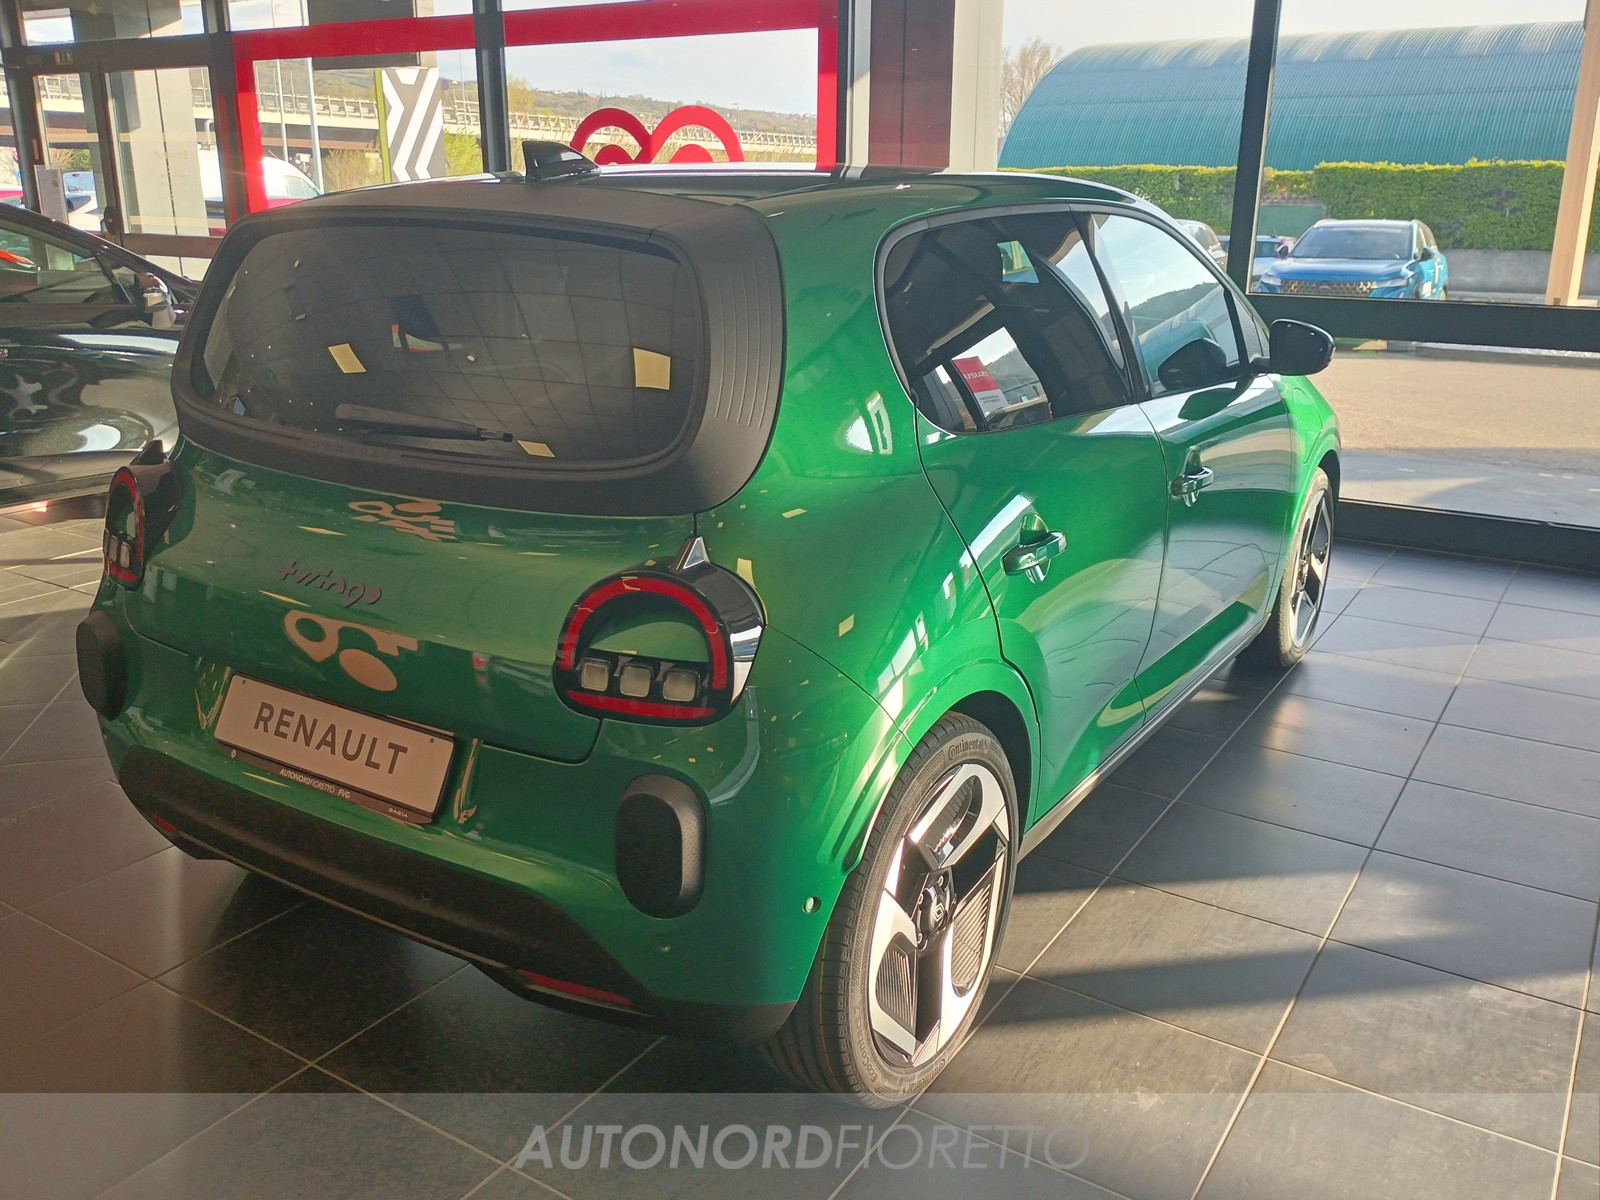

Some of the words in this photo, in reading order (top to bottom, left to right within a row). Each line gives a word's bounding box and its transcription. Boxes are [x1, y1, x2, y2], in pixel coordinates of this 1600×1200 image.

[279, 560, 382, 608] twingo
[253, 702, 408, 775] RENAULT
[948, 739, 984, 760] Continental
[280, 768, 335, 794] AUTONORDFIORETTO
[338, 788, 351, 799] FVG
[388, 807, 408, 818] DACIA
